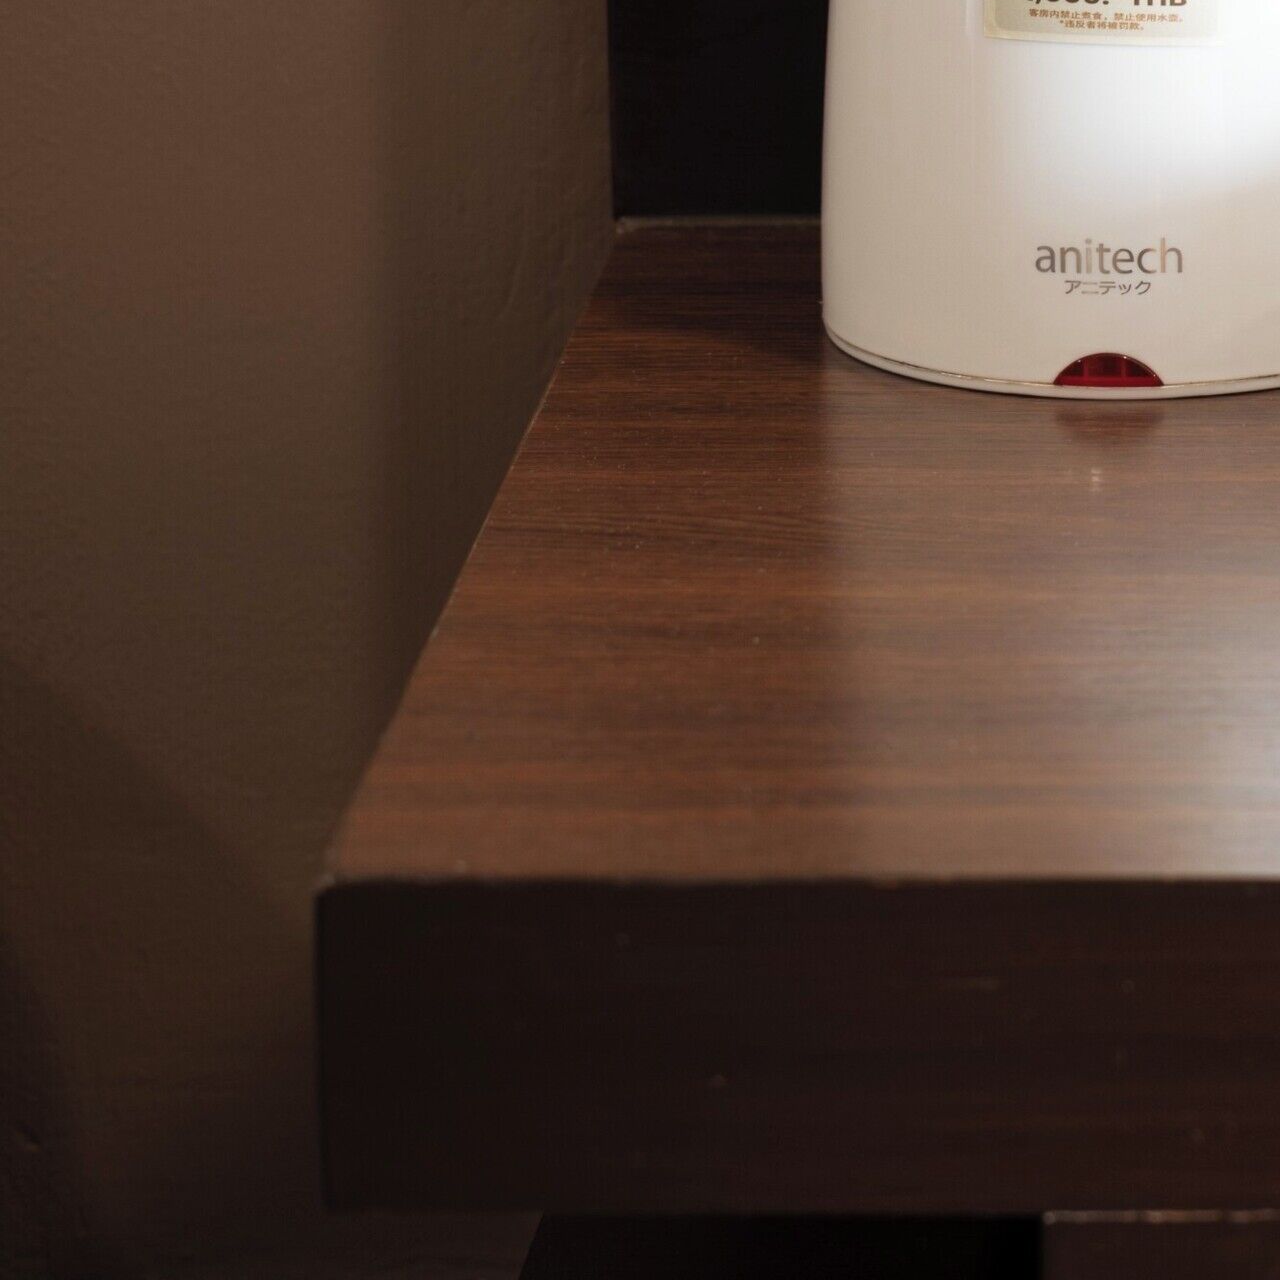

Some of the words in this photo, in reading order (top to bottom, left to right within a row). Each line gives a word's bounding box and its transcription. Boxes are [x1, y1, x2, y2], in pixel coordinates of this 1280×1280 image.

[1035, 237, 1184, 274] anitech
[1064, 280, 1152, 295] アニテック
